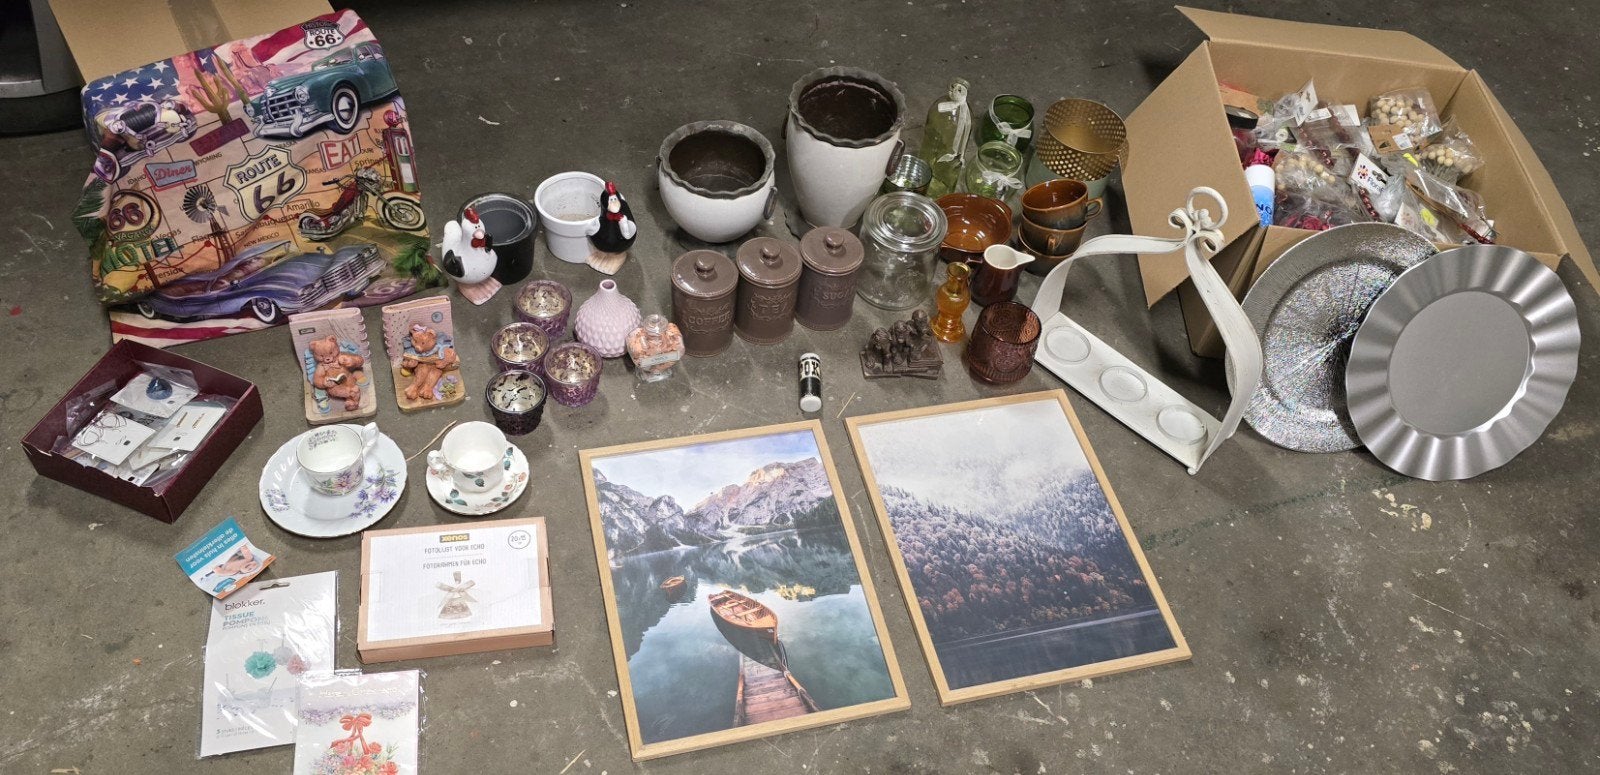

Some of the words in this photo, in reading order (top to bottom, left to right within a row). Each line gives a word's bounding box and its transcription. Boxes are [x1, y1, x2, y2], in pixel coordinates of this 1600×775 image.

[309, 29, 336, 37] ROUTE
[315, 34, 336, 47] 66
[324, 134, 358, 168] EAT
[153, 164, 192, 181] Diner
[235, 153, 282, 185] ROUTE
[253, 170, 296, 214] 66
[286, 200, 320, 213] Amarillo
[107, 202, 144, 231] 66
[441, 534, 468, 542] xenos
[424, 546, 453, 555] FOTOLIJST
[455, 544, 469, 552] VOOR
[471, 558, 487, 566] ECHO
[224, 611, 255, 621] TISSUE
